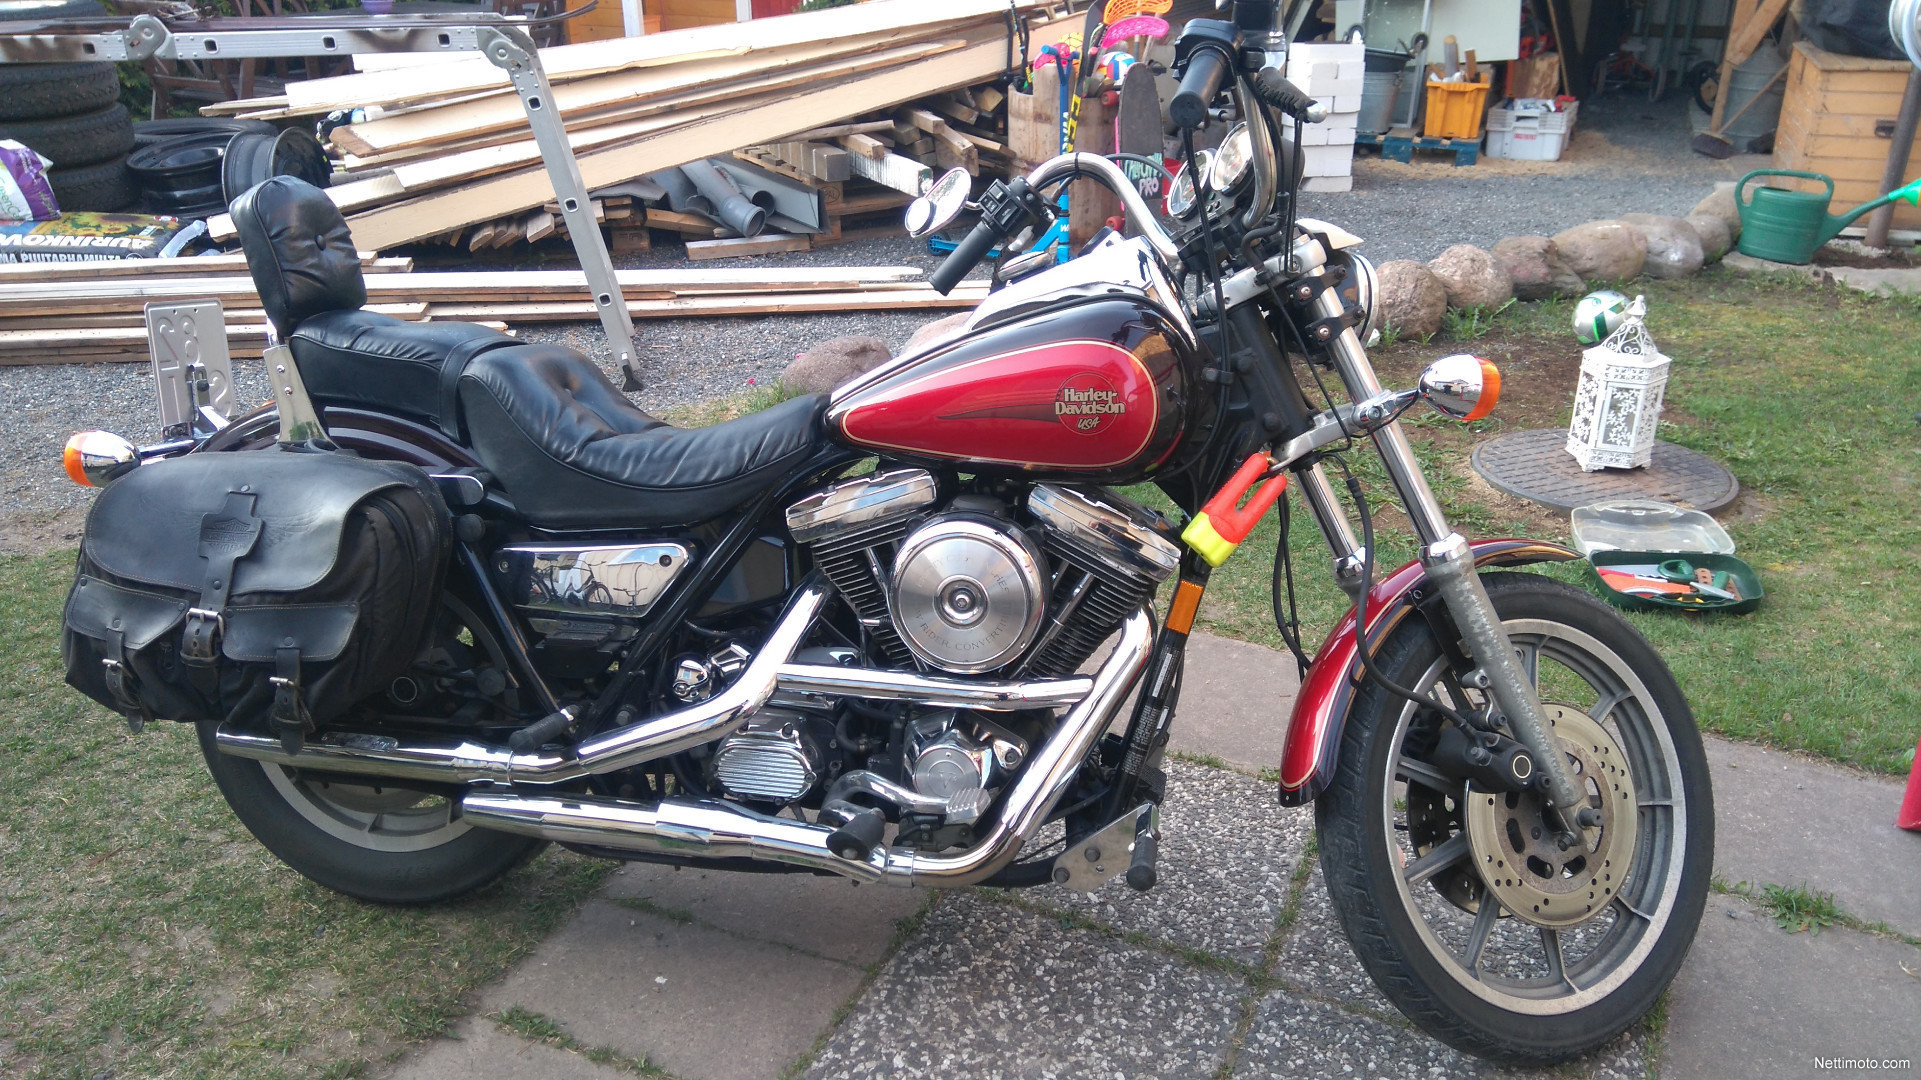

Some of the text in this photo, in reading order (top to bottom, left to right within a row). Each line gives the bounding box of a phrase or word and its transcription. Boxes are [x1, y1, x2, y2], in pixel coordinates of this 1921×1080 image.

[1139, 177, 1159, 196] PRO
[1055, 401, 1126, 415] Davidson
[1077, 416, 1101, 430] USA
